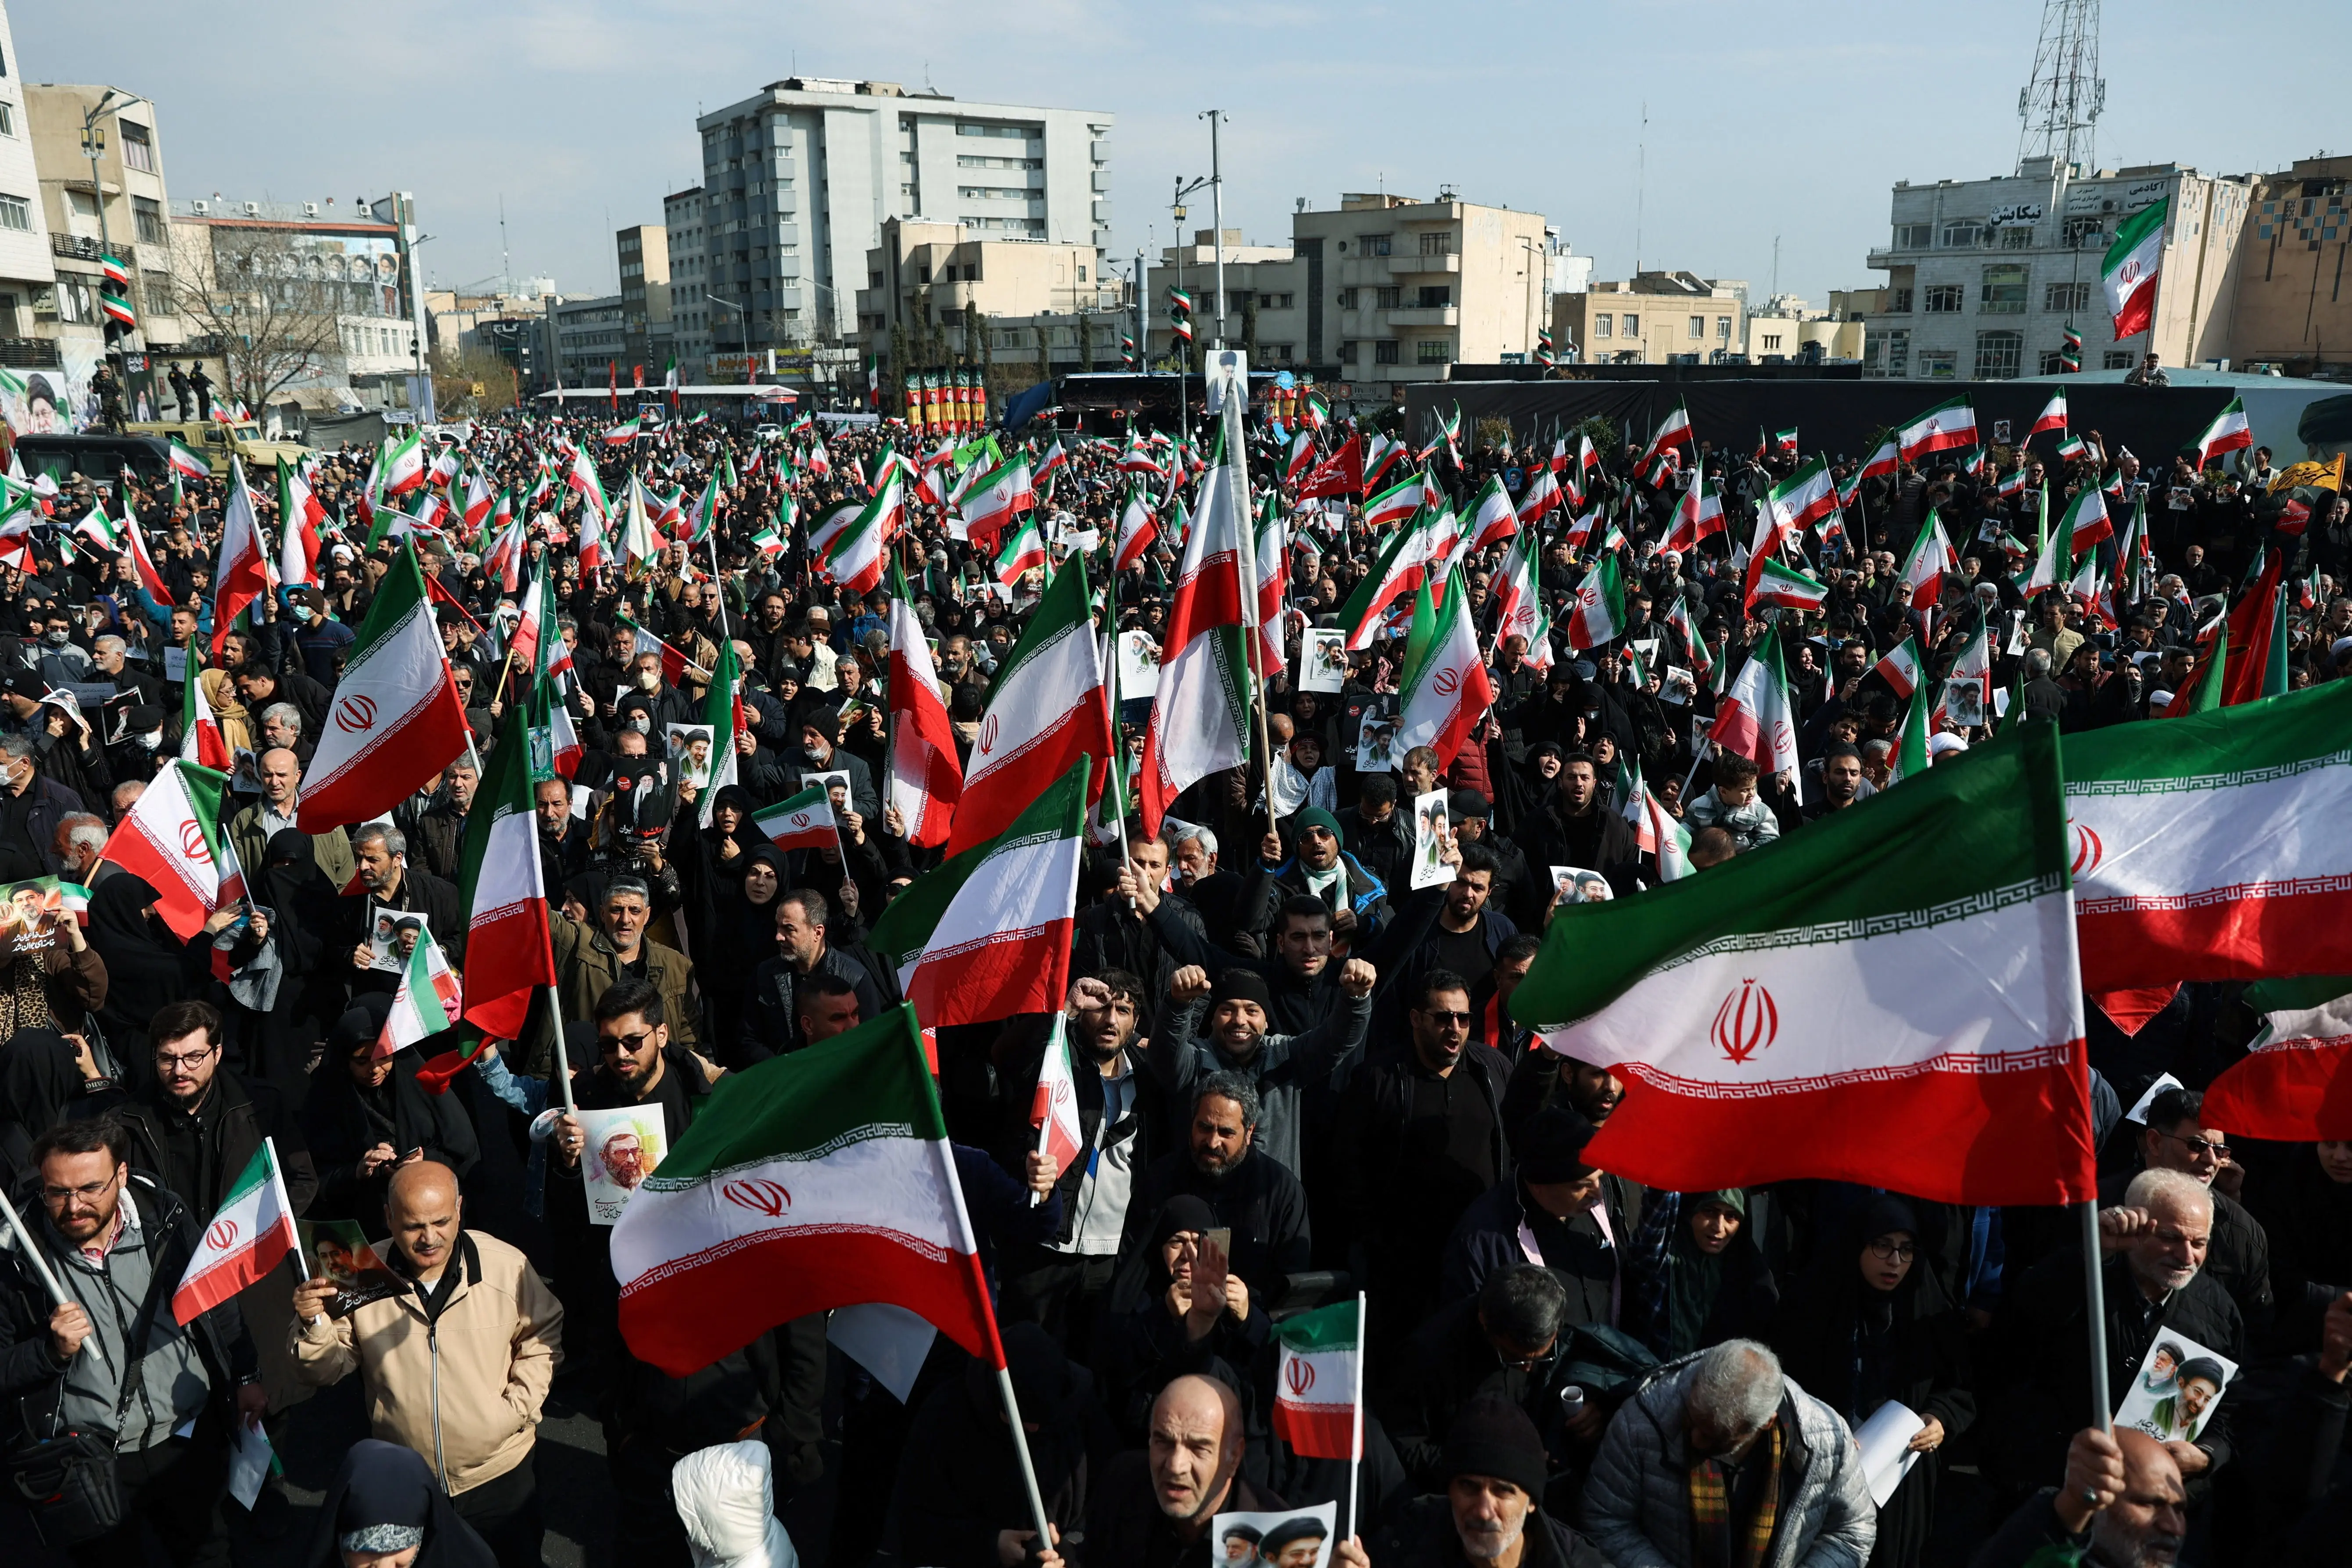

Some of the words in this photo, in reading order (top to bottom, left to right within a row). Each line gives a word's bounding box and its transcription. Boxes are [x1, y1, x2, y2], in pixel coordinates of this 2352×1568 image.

[2129, 181, 2166, 196] آکادمی
[1991, 205, 2041, 226] نیکایش
[493, 322, 519, 340] گاج
[619, 824, 634, 834] ایران
[38, 927, 55, 937] لطف
[11, 933, 20, 943] شد
[20, 933, 32, 942] عیان
[12, 943, 22, 952] شد
[22, 941, 35, 951] جوان
[379, 955, 391, 965] صالح
[388, 958, 399, 966] صالح
[367, 1281, 385, 1290] لطف
[336, 1291, 345, 1302] شد
[344, 1288, 359, 1298] عیان
[353, 1294, 370, 1305] جوان
[343, 1299, 353, 1311] شد
